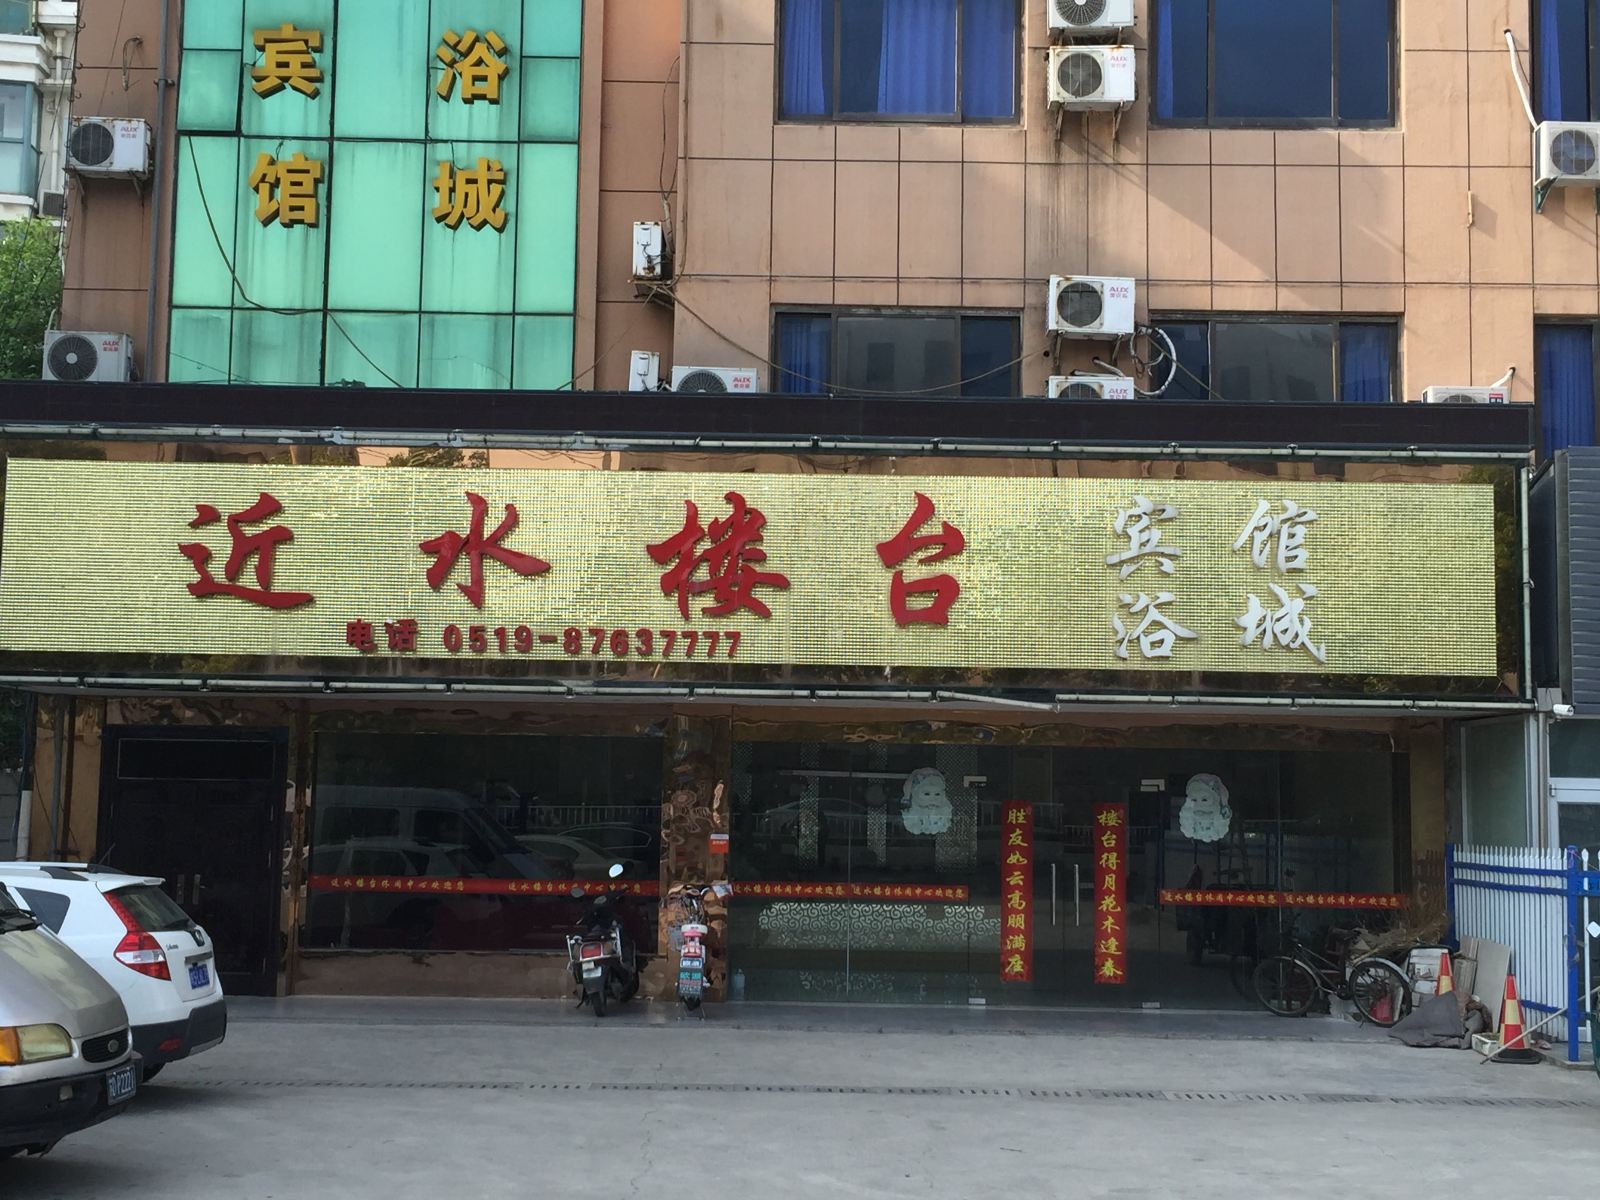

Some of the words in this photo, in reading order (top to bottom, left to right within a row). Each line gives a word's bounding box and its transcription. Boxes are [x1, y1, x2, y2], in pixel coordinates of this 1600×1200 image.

[248, 23, 324, 228] 宾馆
[432, 30, 509, 233] 浴城
[177, 490, 965, 629] 近水楼台
[1105, 495, 1319, 581] 宾馆
[346, 617, 419, 653] 电话
[443, 624, 743, 660] 0519-87637777
[1112, 582, 1327, 664] 浴城
[1006, 808, 1028, 974] 胜友如云高朋满座
[1097, 810, 1124, 977] 楼台得月花木逢春
